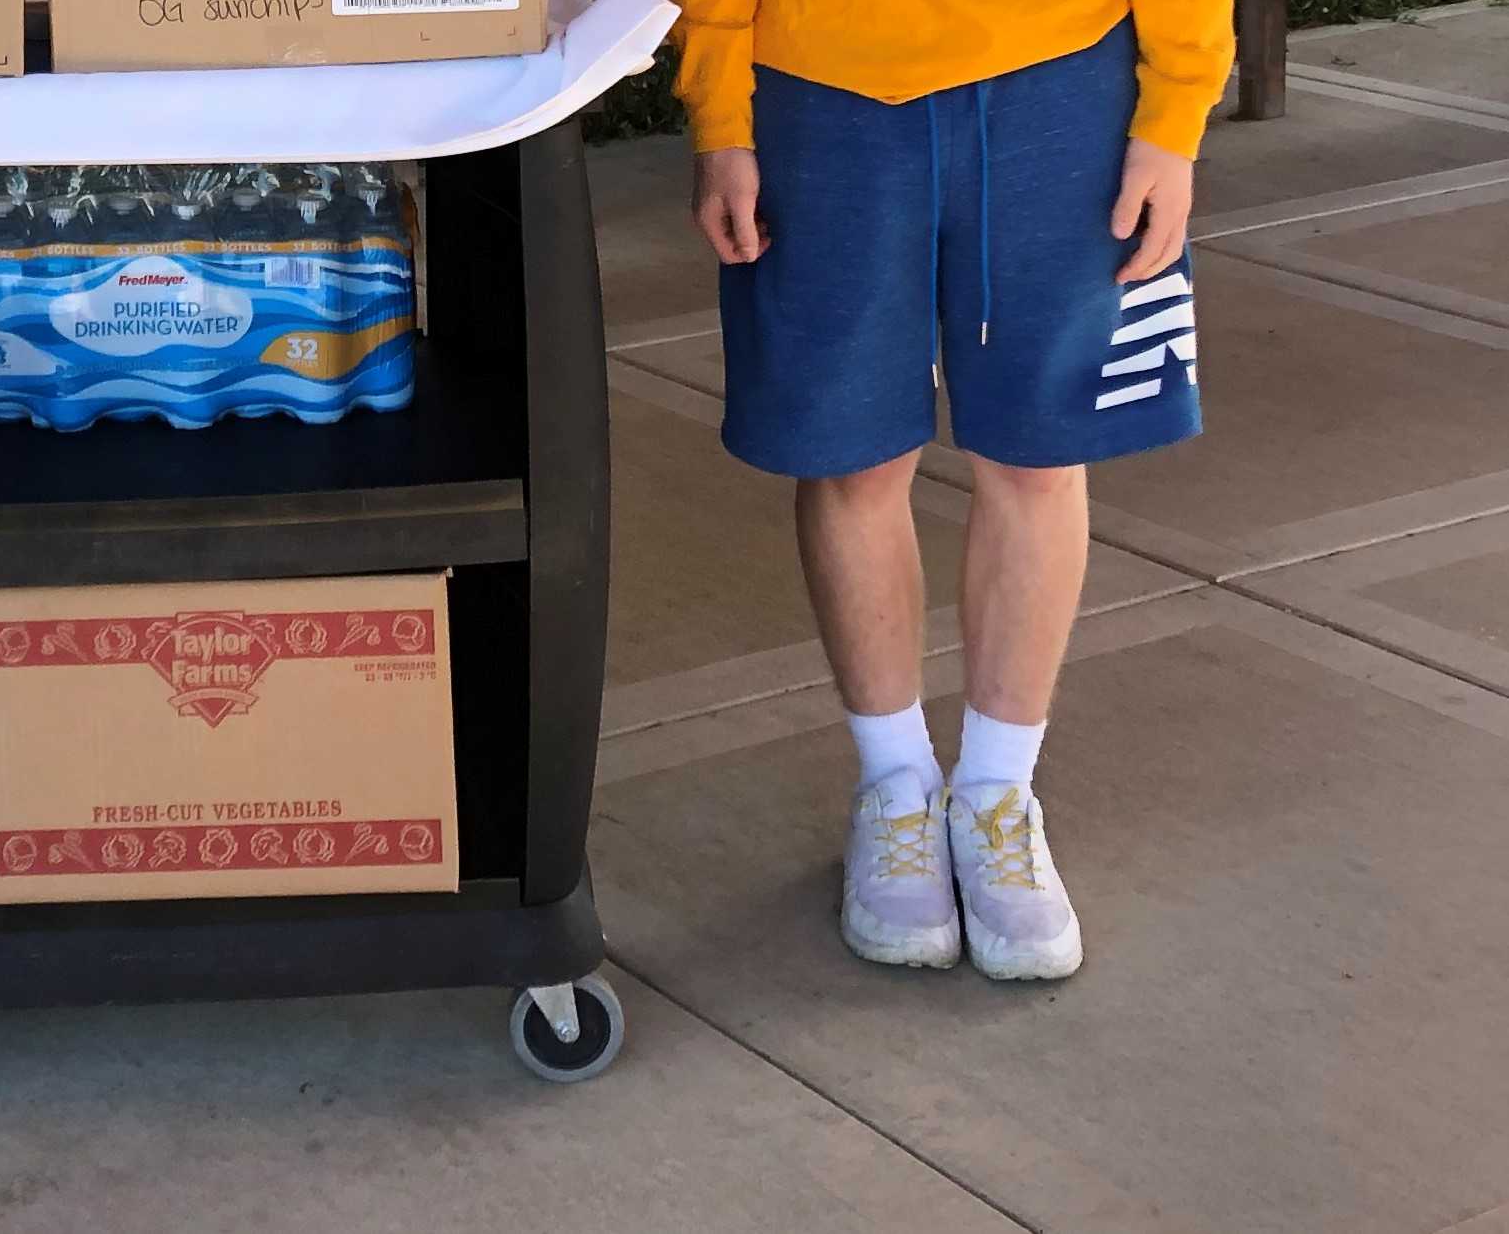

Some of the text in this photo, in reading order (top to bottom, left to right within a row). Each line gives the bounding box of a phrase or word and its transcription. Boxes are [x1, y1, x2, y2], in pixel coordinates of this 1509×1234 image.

[113, 301, 201, 318] PURIFIED
[74, 316, 239, 338] DRINKING WATER
[287, 337, 319, 360] 32
[171, 625, 252, 664] Taylor
[171, 659, 253, 686] Farms
[91, 800, 342, 823] FRESH-CUT VEGETABLES
